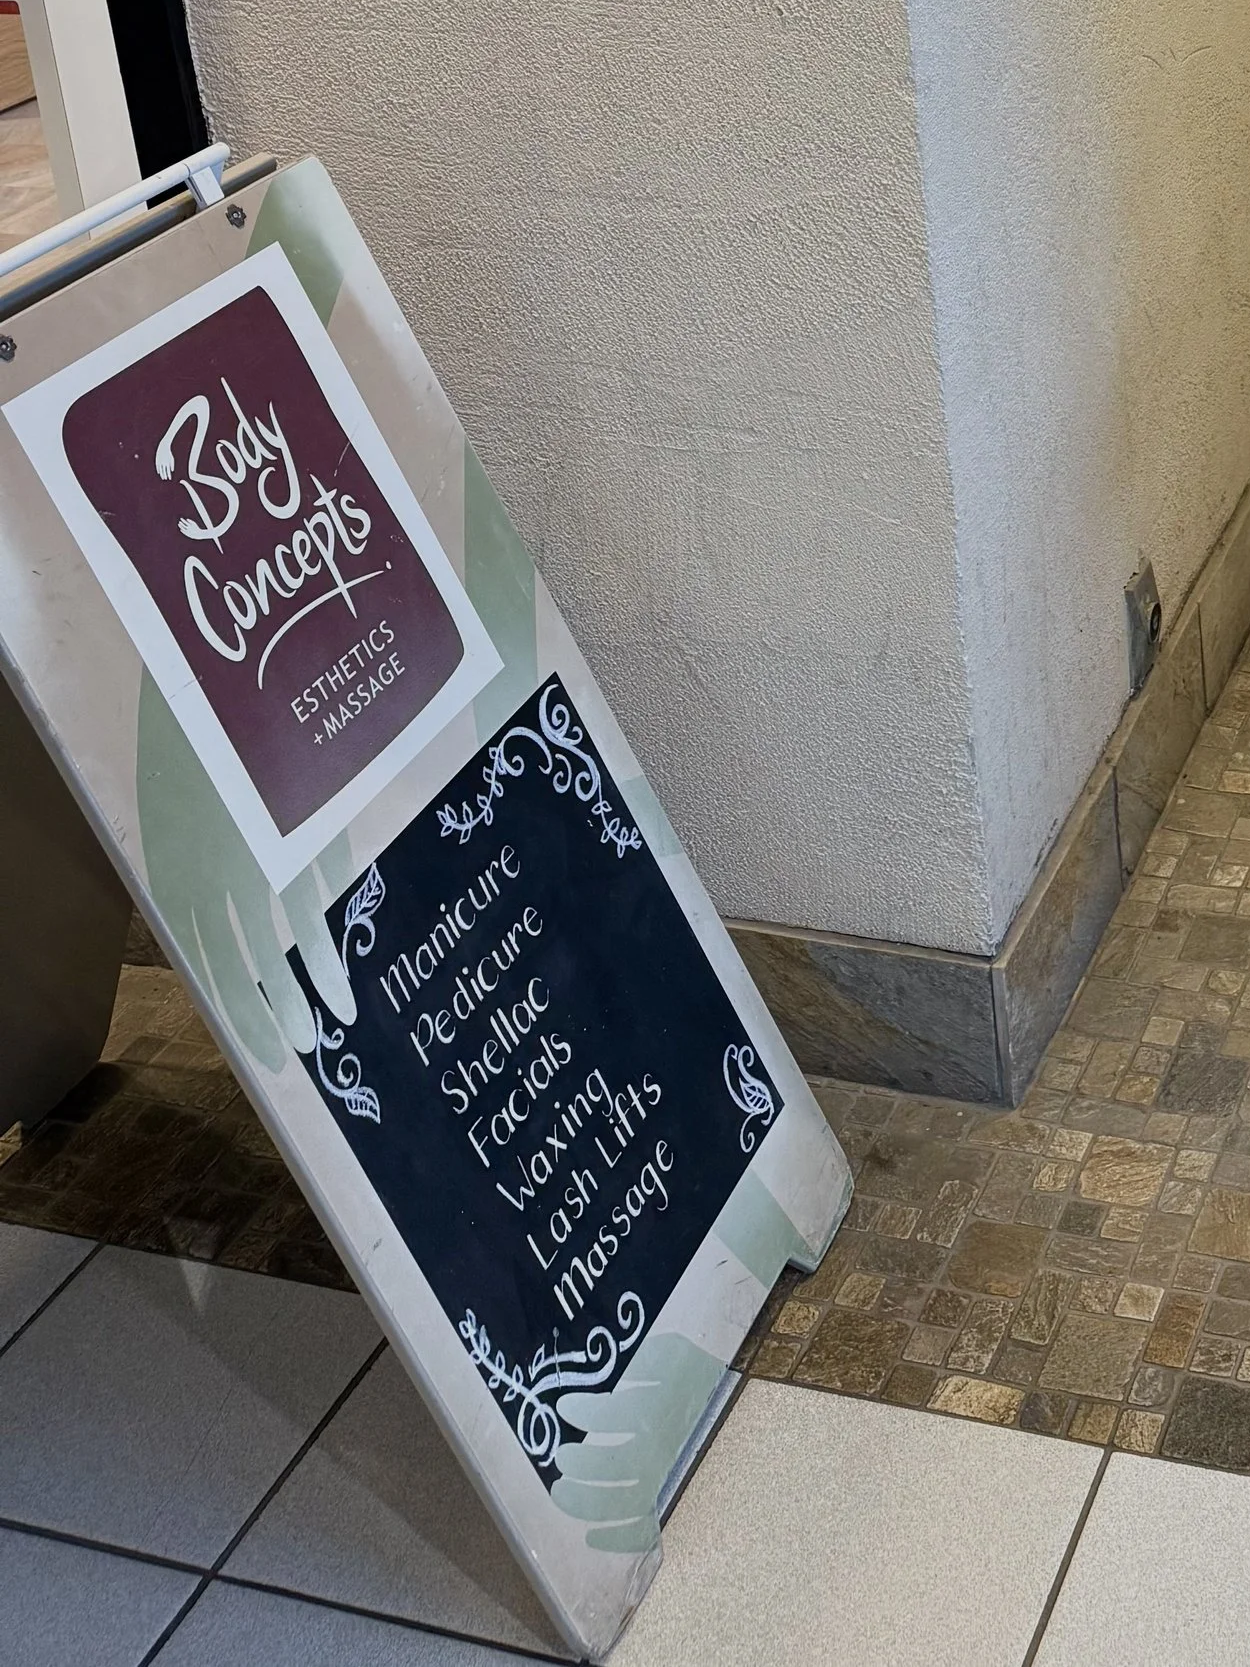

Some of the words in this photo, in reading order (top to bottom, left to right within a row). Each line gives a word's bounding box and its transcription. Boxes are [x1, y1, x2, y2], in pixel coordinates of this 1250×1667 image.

[155, 377, 302, 554] Body
[183, 472, 373, 663] Concepts
[290, 619, 396, 724] ESTHETICS
[379, 842, 521, 1015] Manicure
[409, 905, 543, 1067] Pedicure
[440, 975, 551, 1116] Shellac
[467, 1031, 573, 1168] Facials
[496, 1065, 613, 1214] Waxing
[525, 1166, 600, 1271] Lash
[594, 1072, 662, 1167] Lifts
[551, 1137, 674, 1321] Massage
